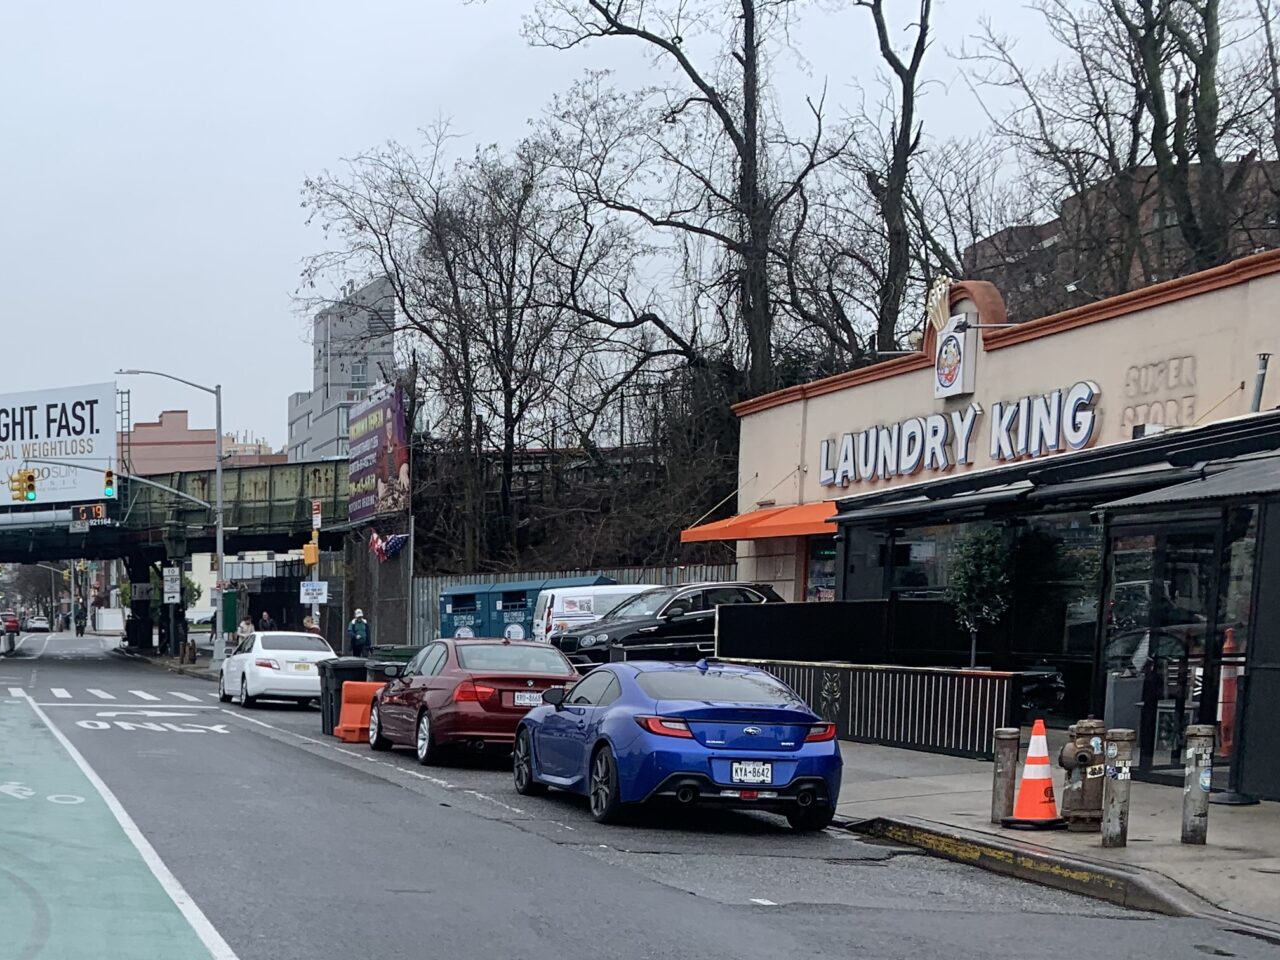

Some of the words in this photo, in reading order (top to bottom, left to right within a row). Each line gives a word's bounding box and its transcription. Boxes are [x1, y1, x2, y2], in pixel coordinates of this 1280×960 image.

[46, 399, 100, 438] FAST.
[819, 402, 983, 487] LAUNDRY
[990, 380, 1102, 462] KING
[21, 438, 94, 459] WEIGHTLOSS
[75, 720, 230, 733] ONLY
